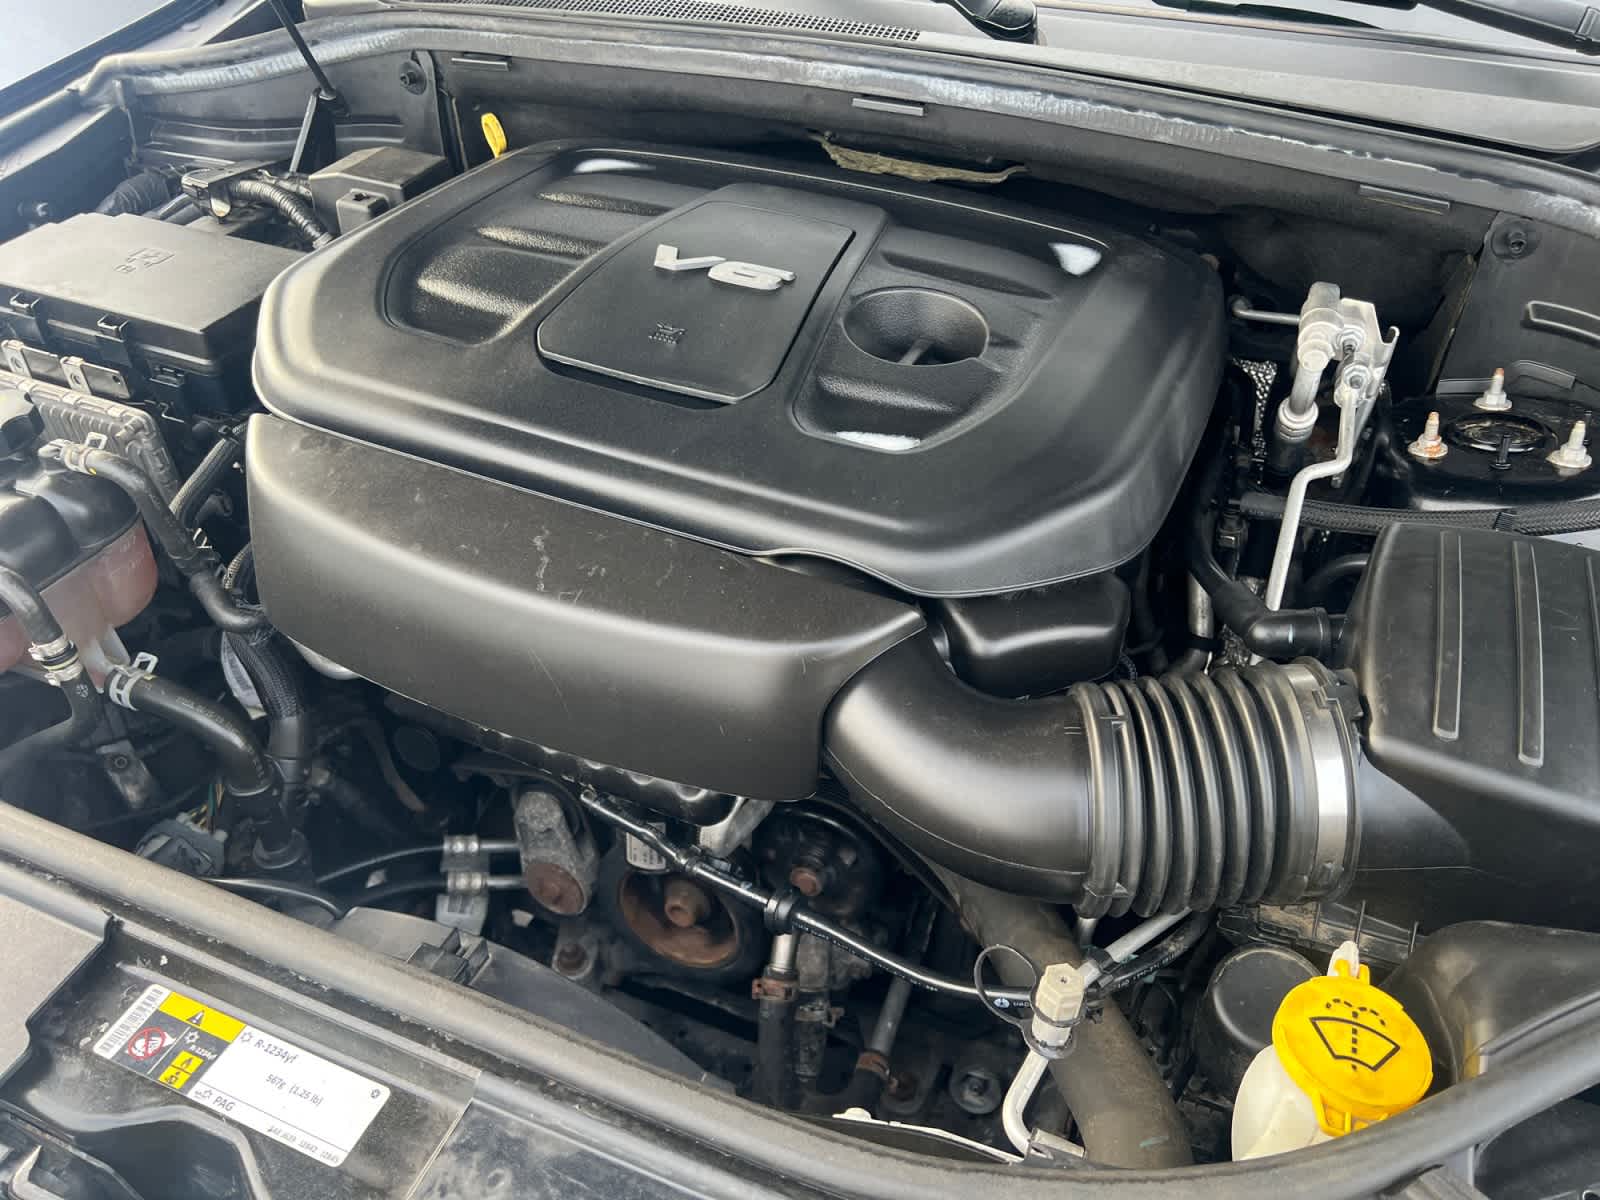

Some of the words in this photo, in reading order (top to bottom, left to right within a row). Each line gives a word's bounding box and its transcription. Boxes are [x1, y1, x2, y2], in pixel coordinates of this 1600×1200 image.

[653, 243, 796, 291] V6
[254, 1039, 298, 1064] R-1234yf
[266, 1073, 287, 1090] 567g
[213, 1096, 236, 1112] PAG
